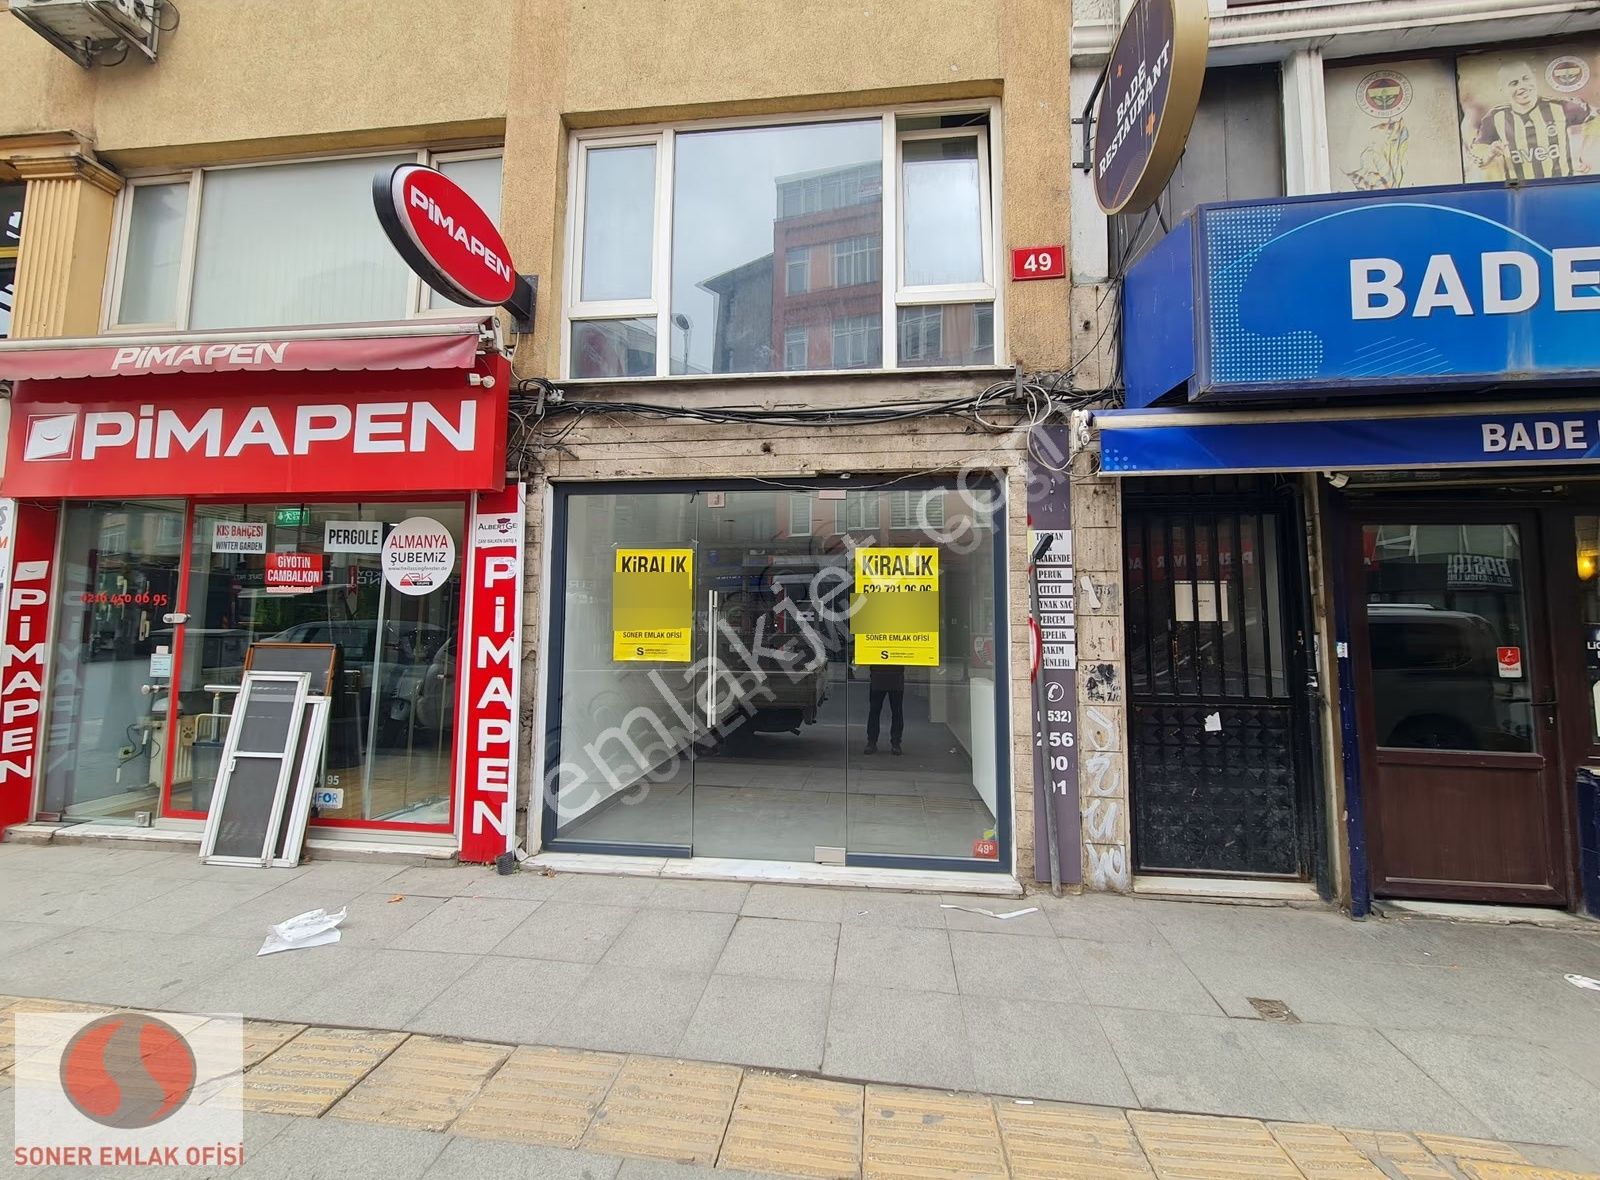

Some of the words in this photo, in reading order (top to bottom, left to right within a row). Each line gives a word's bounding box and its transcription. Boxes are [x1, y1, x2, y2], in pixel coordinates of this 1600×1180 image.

[1116, 60, 1147, 126] BADE
[1099, 40, 1170, 179] RESTAURANT
[1511, 144, 1560, 164] avea
[1023, 253, 1052, 273] 49
[1350, 246, 1600, 320] BADE
[1481, 420, 1587, 452] BADE
[328, 529, 379, 545] PERGOLE
[389, 534, 449, 549] ALMANYA
[215, 541, 238, 550] WINTER
[239, 541, 263, 551] GARDEN
[267, 570, 320, 583] CAMBALKON
[1038, 570, 1062, 579] PERUK
[153, 594, 168, 606] 95
[865, 634, 887, 642] SONER
[889, 634, 911, 642] EMLAK
[1037, 710, 1072, 723] (532)
